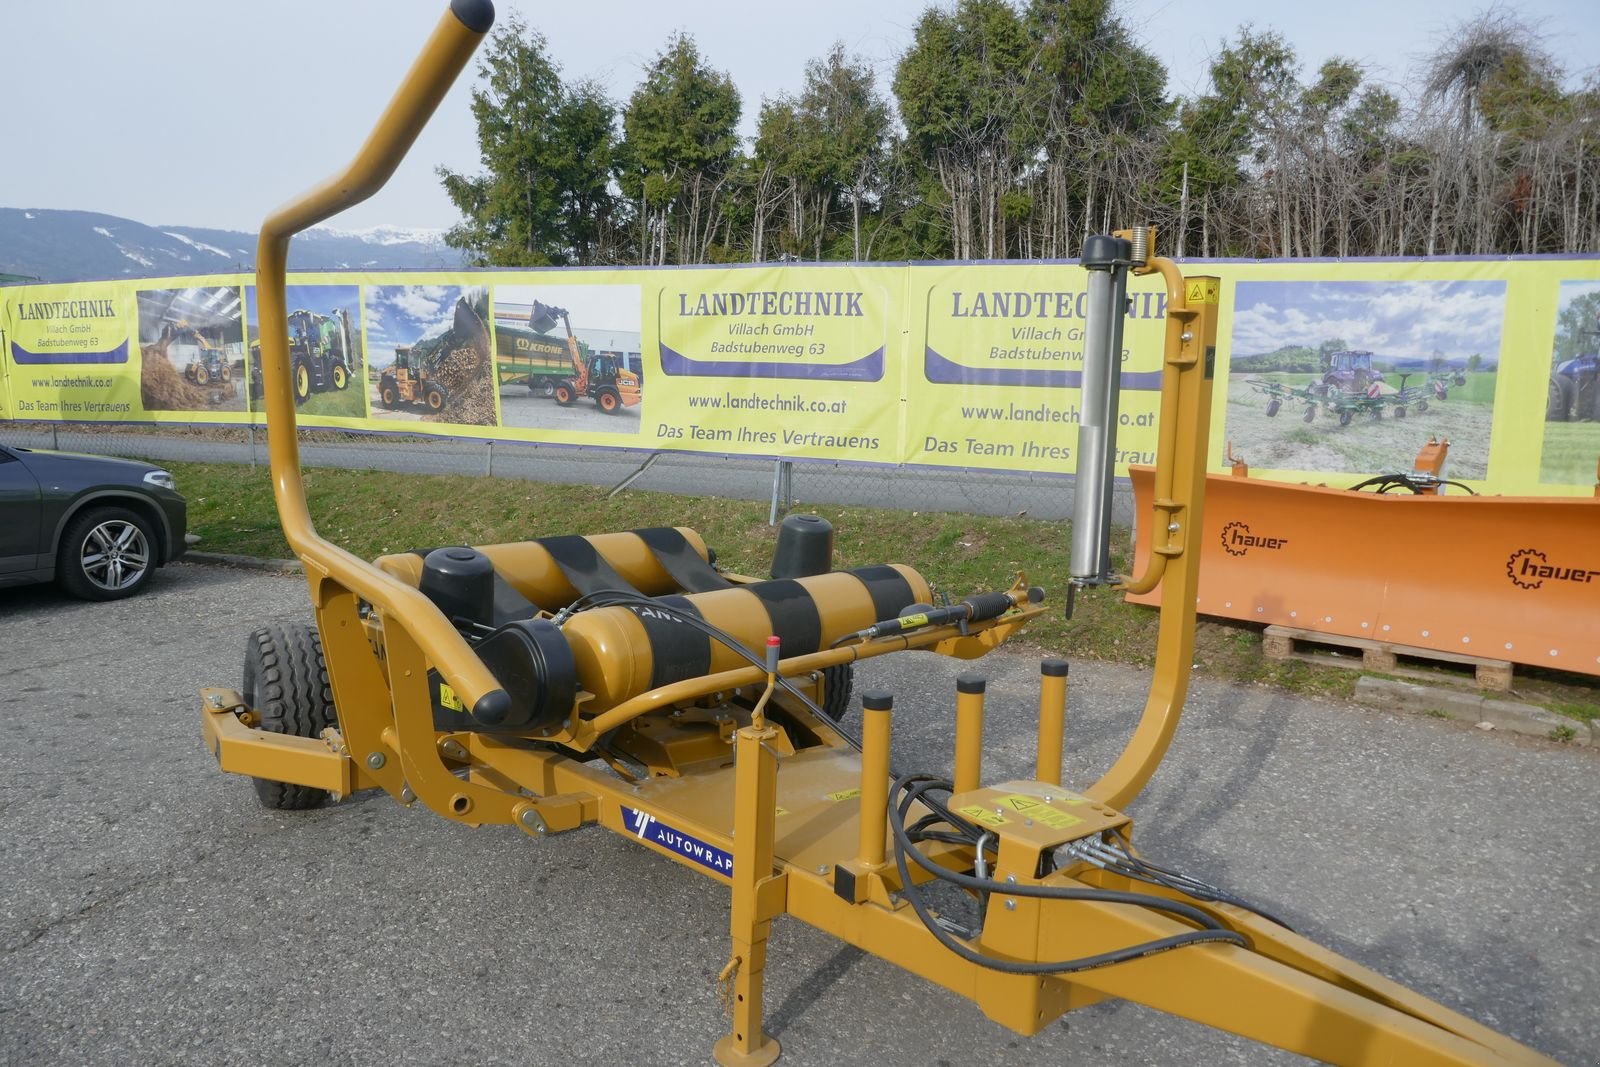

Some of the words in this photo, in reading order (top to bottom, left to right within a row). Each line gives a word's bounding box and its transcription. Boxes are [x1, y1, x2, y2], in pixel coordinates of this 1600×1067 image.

[18, 300, 115, 320] LANDTECHNIK
[679, 291, 864, 317] LANDTECHNIK
[952, 292, 1167, 319] LANDTECNIK
[70, 324, 91, 333] GmbH
[729, 323, 769, 336] Villach
[773, 325, 814, 336] GmbH
[1012, 327, 1061, 341] Villach
[37, 339, 87, 348] Badstubenweg
[90, 337, 98, 346] 63
[530, 343, 563, 354] KRONE
[711, 341, 804, 357] Badstubenweg
[809, 343, 825, 355] 63
[990, 346, 1083, 361] Badstubenw
[32, 375, 113, 388] www.landtechnik.co.at
[19, 400, 34, 411] Das
[37, 400, 58, 411] Team
[61, 400, 82, 412] Ihres
[84, 401, 130, 412] Vertrauens
[689, 392, 847, 413] www.landtechnik.co.at
[656, 423, 683, 438] Das
[690, 425, 732, 441] Team
[737, 427, 776, 443] Ihres
[783, 429, 879, 449] Vertrauens
[924, 437, 958, 453] Das
[965, 439, 1014, 456] Team
[1021, 441, 1070, 459] Ihres
[1231, 529, 1288, 550] hauer
[1520, 557, 1600, 583] hauer
[657, 829, 733, 870] AUTOWRAP
